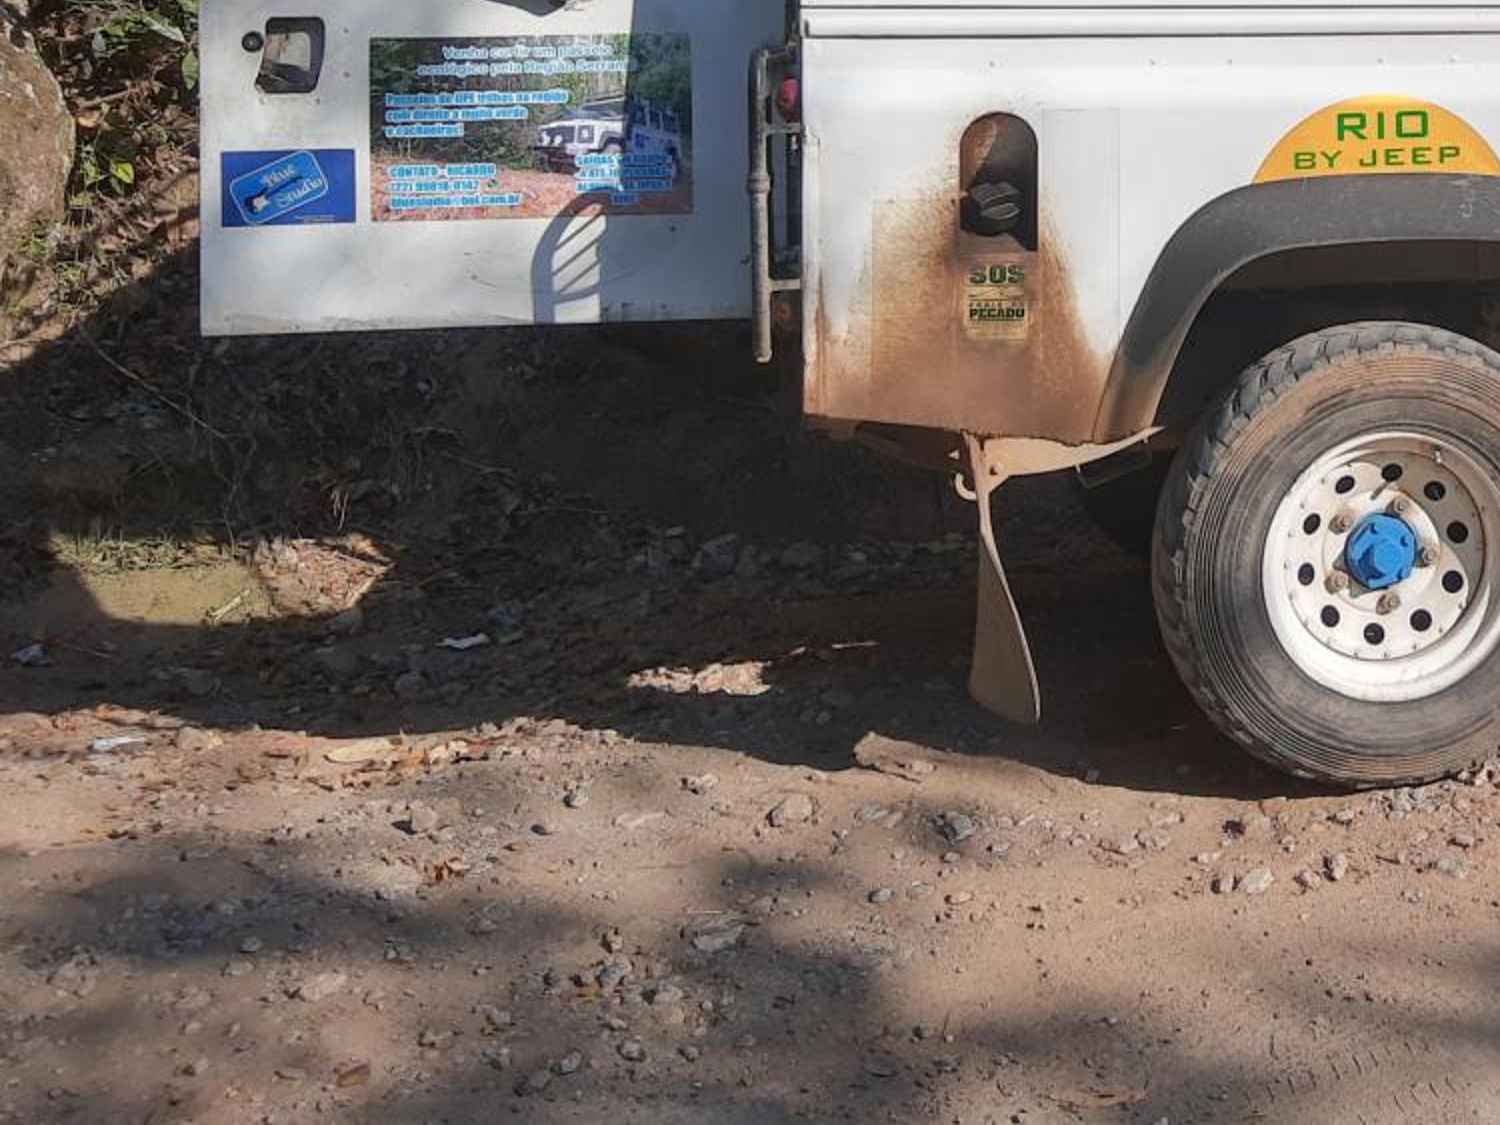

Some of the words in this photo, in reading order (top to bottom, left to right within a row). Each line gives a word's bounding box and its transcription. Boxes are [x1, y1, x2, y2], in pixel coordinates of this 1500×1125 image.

[1337, 110, 1428, 141] RIO
[1293, 150, 1342, 170] BY
[1359, 146, 1461, 167] JEEP
[969, 265, 1024, 284] SOS
[969, 308, 1025, 319] PECADO
